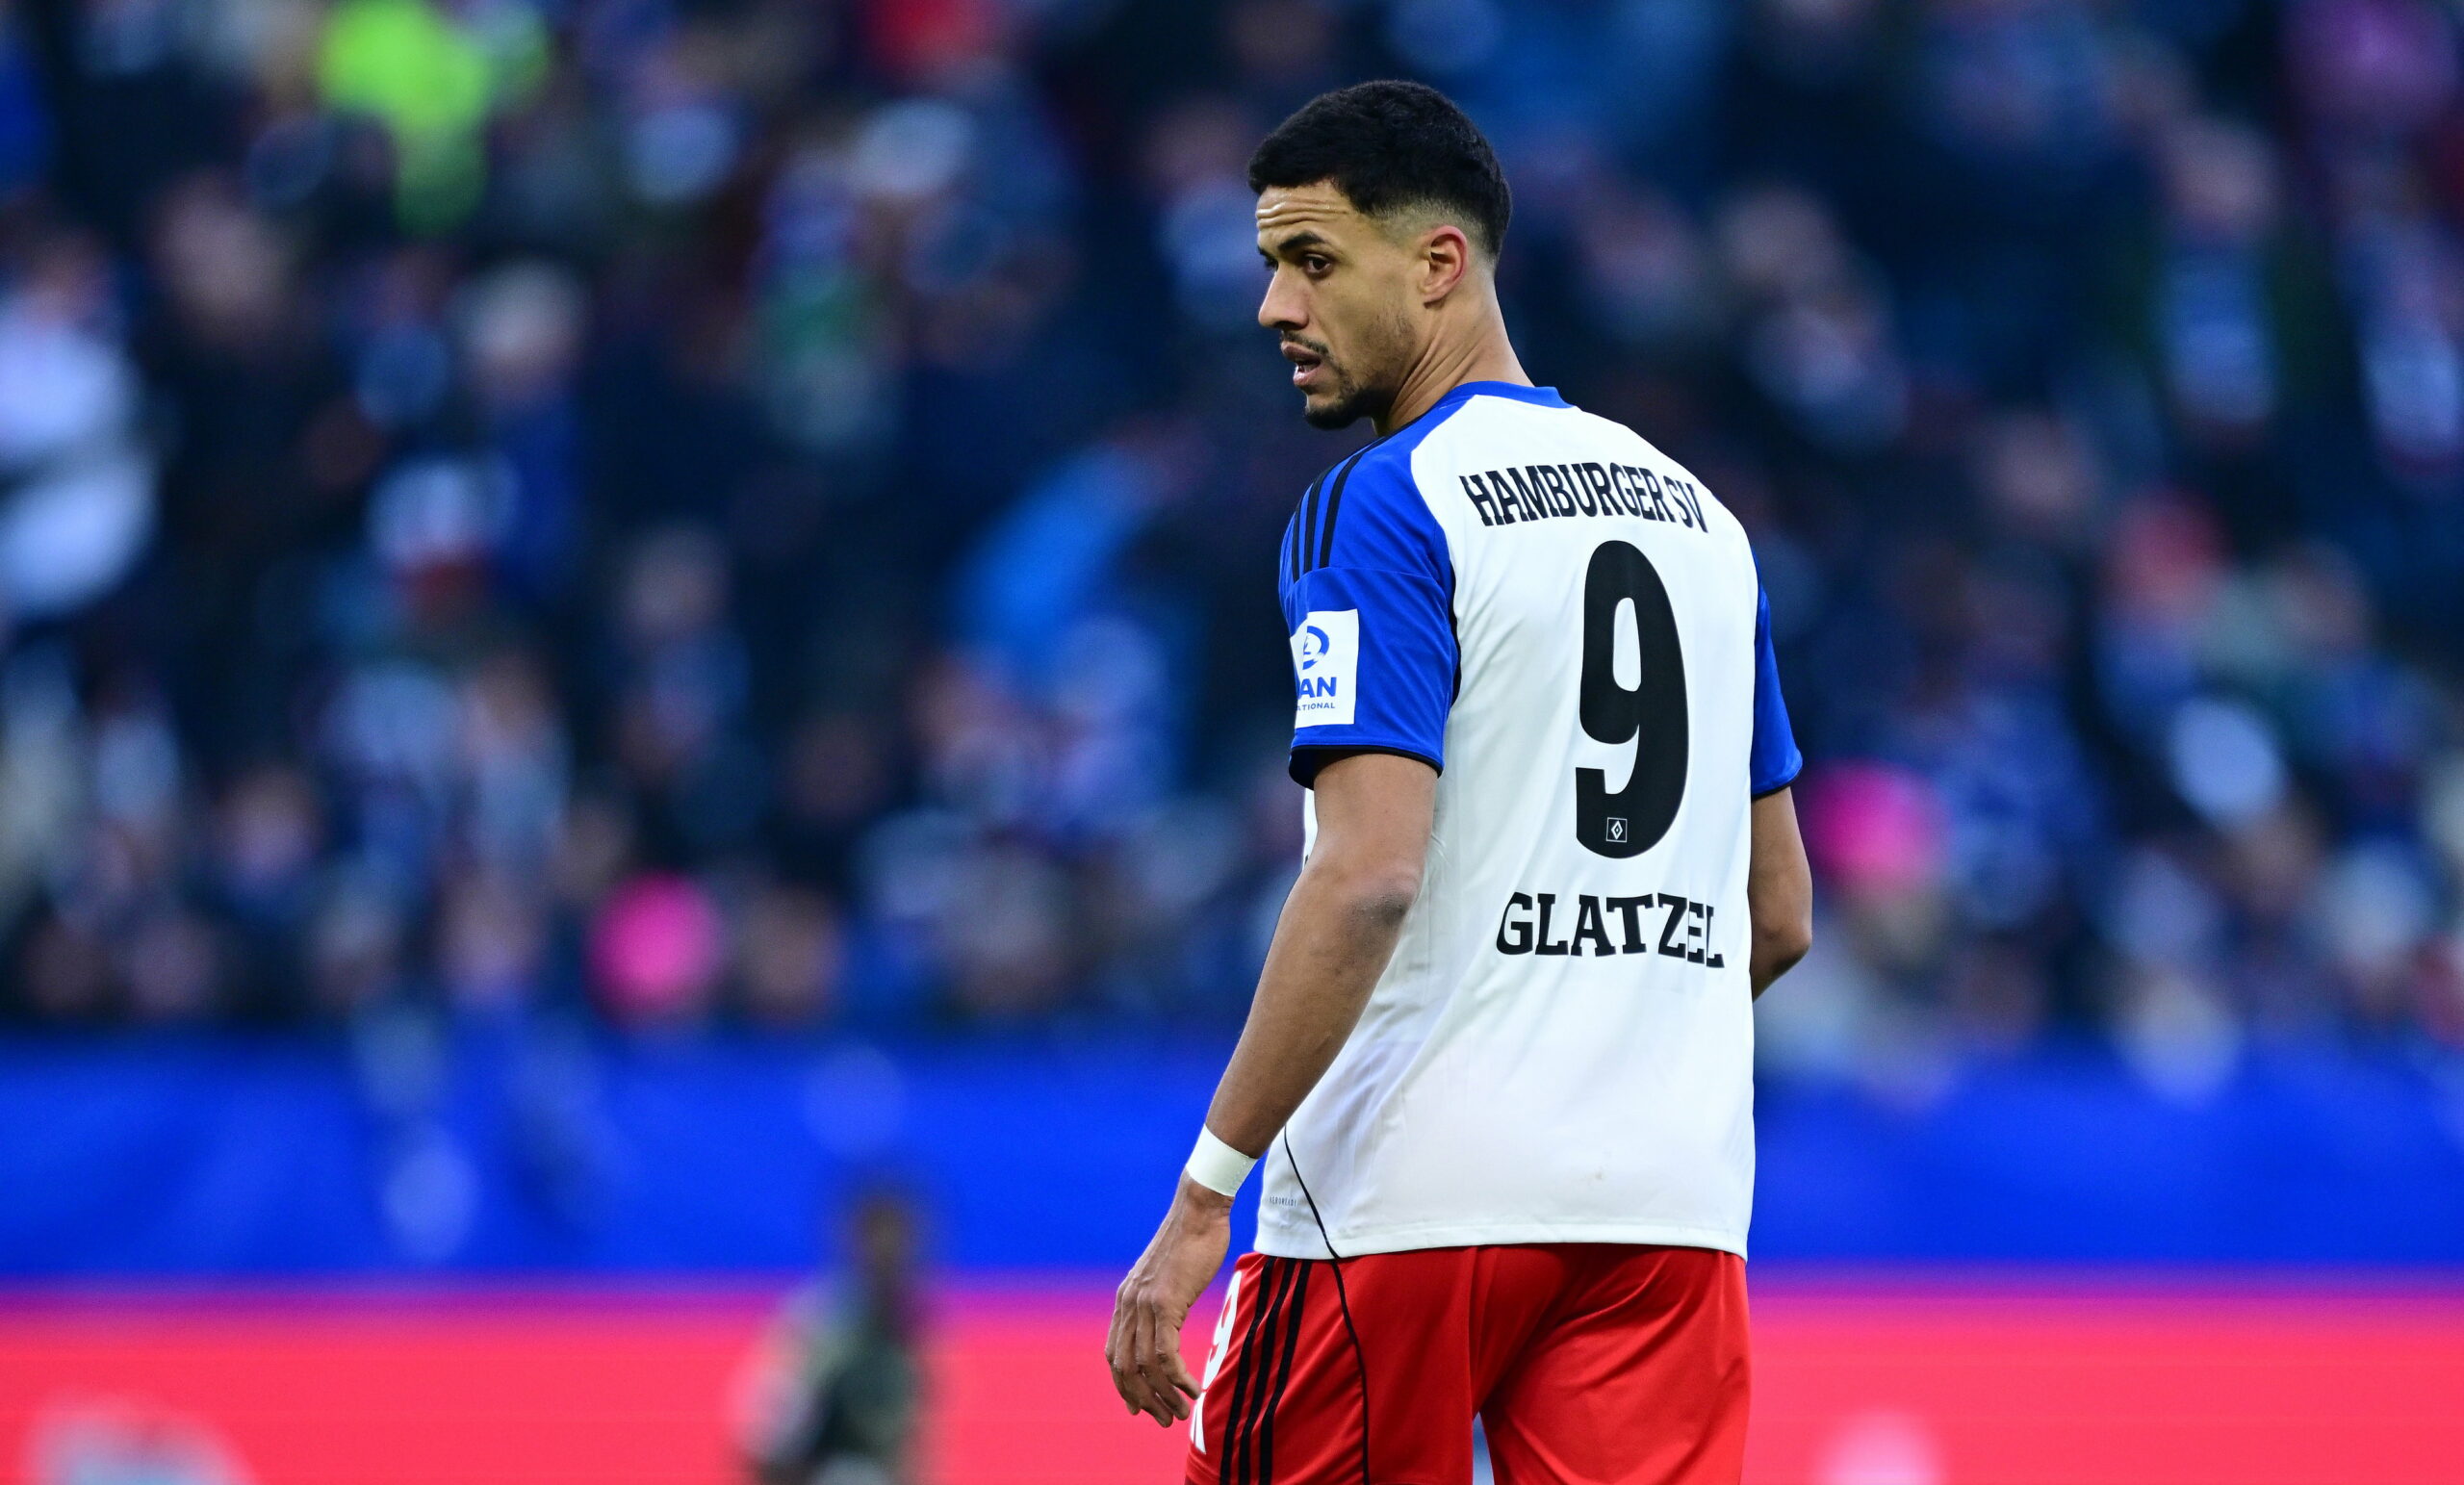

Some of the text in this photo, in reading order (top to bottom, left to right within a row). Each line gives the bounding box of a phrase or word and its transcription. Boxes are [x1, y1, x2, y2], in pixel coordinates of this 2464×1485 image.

[1458, 462, 1708, 533] HAMBURGER SV
[1298, 677, 1337, 699] AN
[1575, 540, 1689, 859] 9
[1496, 891, 1725, 968] GLATZEL
[1202, 1269, 1243, 1391] 9
